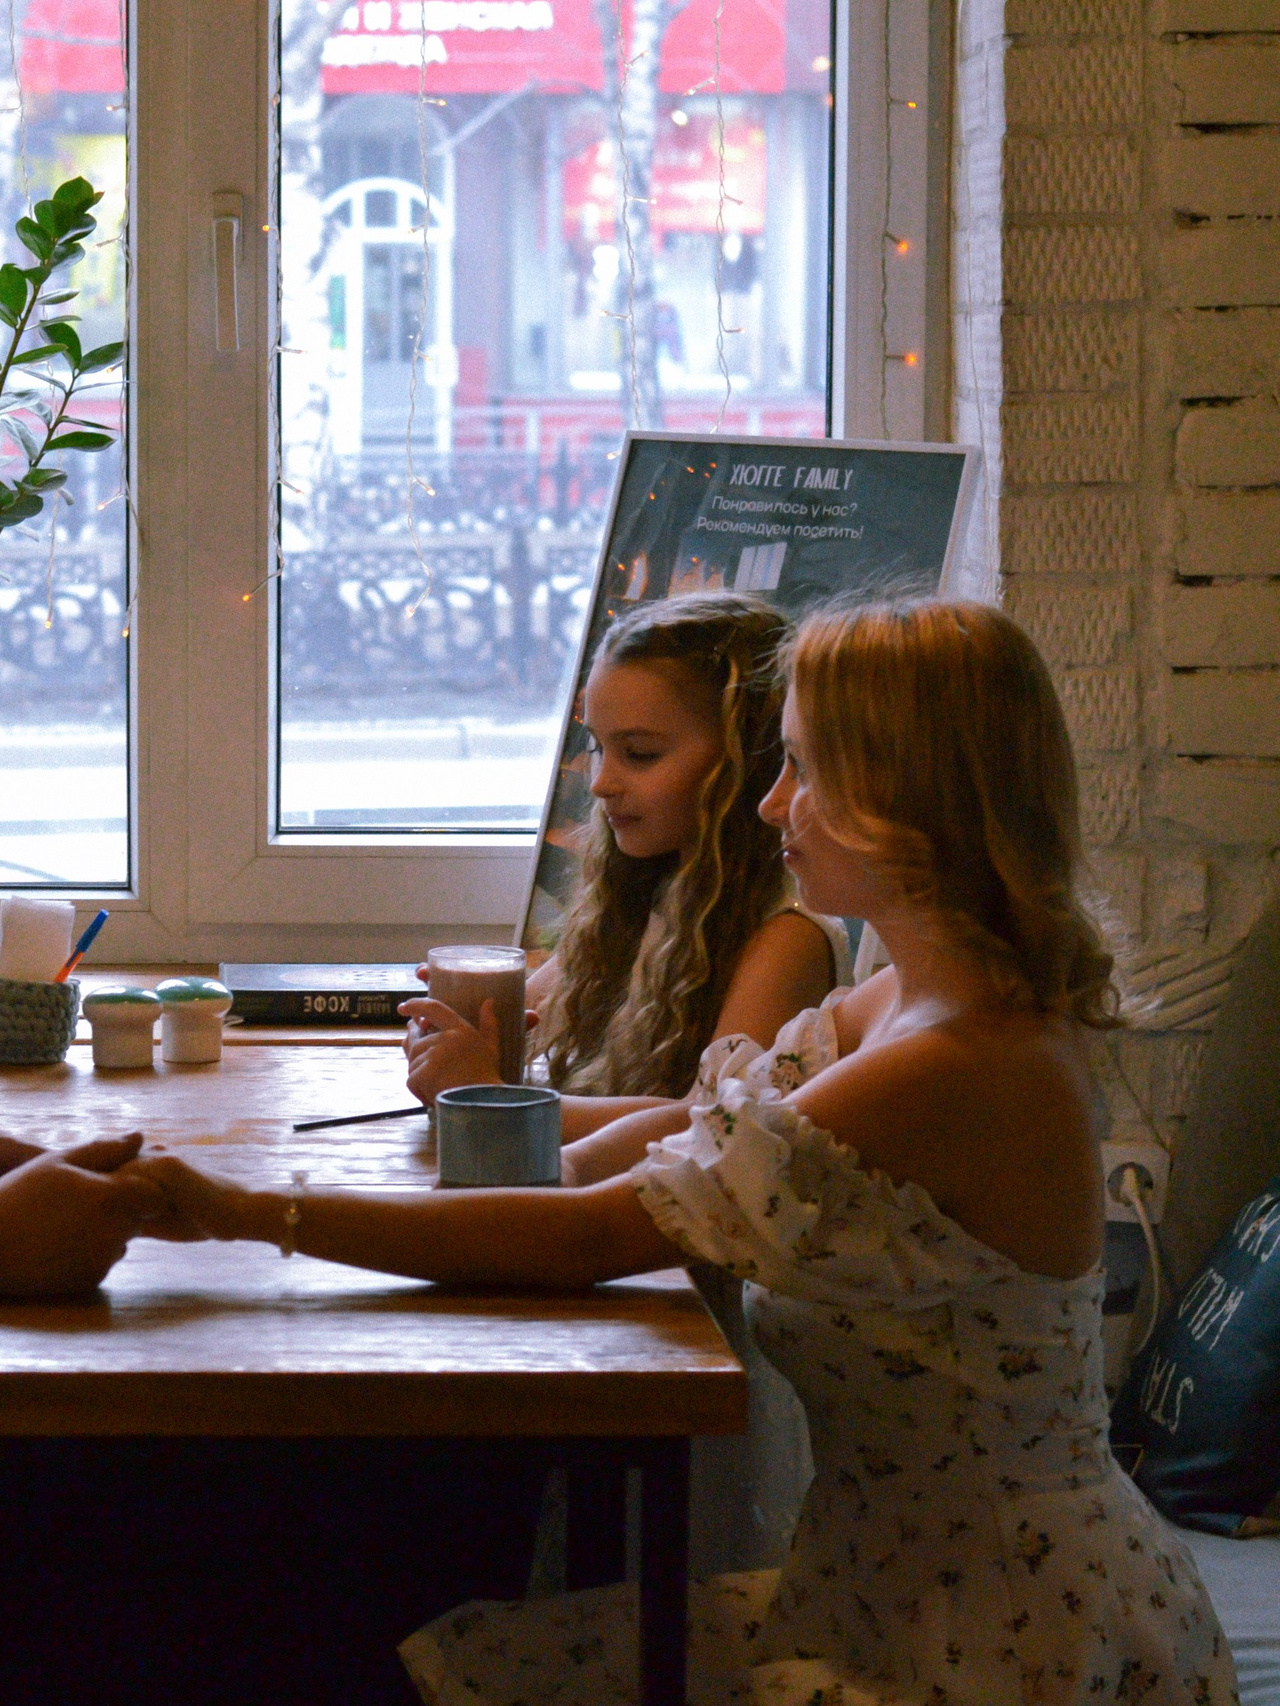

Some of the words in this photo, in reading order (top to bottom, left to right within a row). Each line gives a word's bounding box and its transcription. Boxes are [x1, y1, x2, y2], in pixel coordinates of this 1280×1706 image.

[793, 466, 854, 491] FAMILY
[711, 496, 808, 515] Понравилось
[810, 503, 821, 519] у
[822, 502, 858, 517] нас?
[697, 516, 791, 537] Рекомендуем
[793, 524, 864, 540] посетить!
